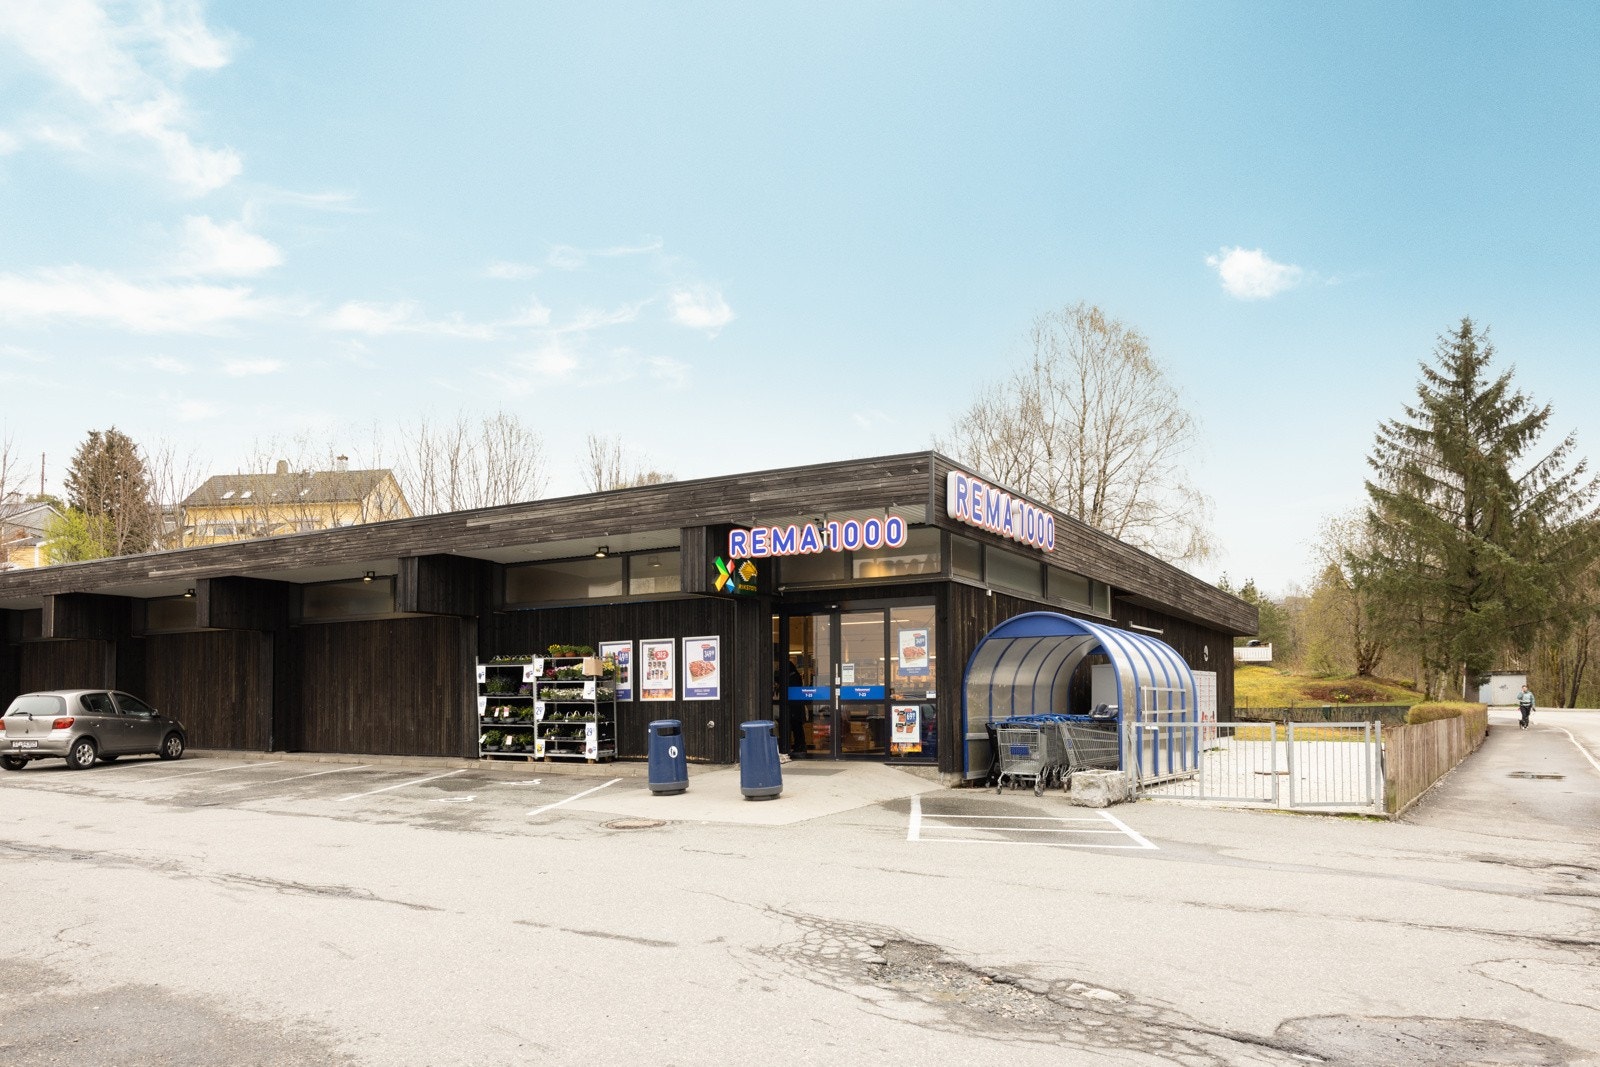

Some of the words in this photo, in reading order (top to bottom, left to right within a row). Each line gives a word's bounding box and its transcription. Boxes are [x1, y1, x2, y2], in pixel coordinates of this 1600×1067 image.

[730, 522, 820, 557] REMA
[828, 517, 905, 550] 1000
[955, 473, 1014, 537] REMA
[1018, 501, 1055, 551] 1000
